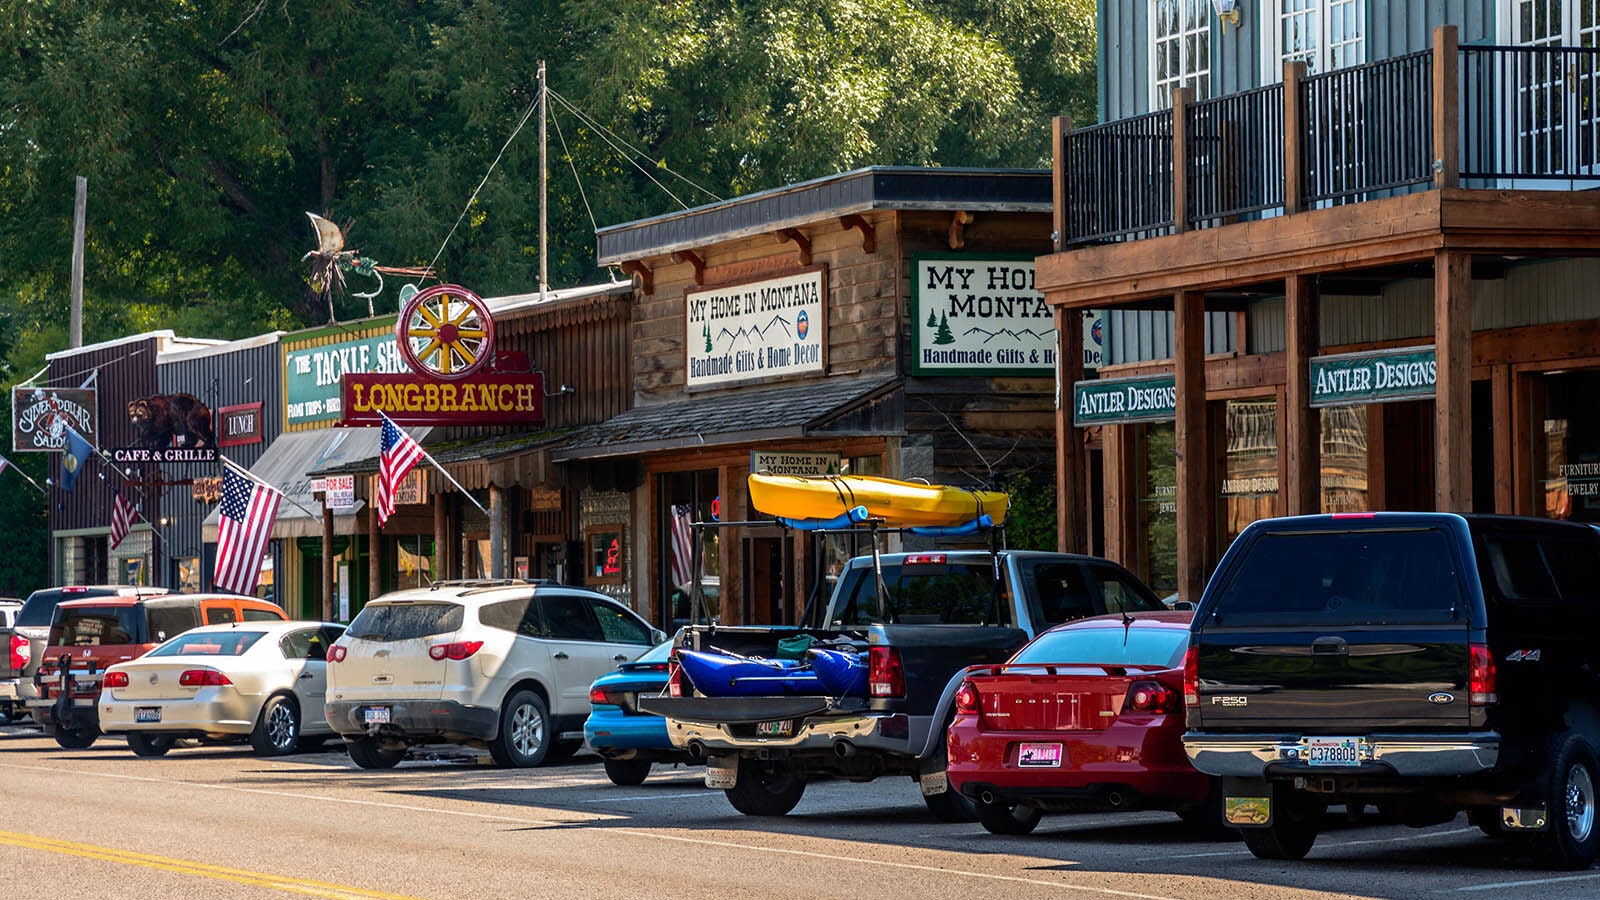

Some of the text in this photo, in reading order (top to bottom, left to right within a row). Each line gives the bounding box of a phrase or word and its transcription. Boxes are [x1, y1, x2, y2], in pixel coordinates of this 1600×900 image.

[927, 266, 1035, 290] MY HO
[690, 280, 819, 323] MY HOME IN MONTANA
[295, 354, 312, 375] THE
[314, 345, 371, 386] TACKLE
[690, 342, 820, 378] Handmade Gifts & Home Decor
[923, 349, 992, 364] Handmade
[997, 349, 1025, 364] Gifts
[1029, 350, 1039, 364] &
[1315, 361, 1436, 395] ANTLER DESIGNS
[353, 383, 535, 412] LONGBRANCH
[1079, 386, 1176, 415] ANTLER DESIGNS
[58, 400, 94, 434] DOLLAR
[229, 414, 254, 436] LUNCH
[33, 430, 66, 448] SALO
[115, 449, 215, 461] CAFE & GRILLE
[759, 456, 827, 465] MY HOME IN
[767, 466, 819, 475] MONTANA
[1559, 463, 1600, 477] FURNITUR
[1251, 476, 1279, 492] DESIGN
[1568, 482, 1599, 496] EWELRY
